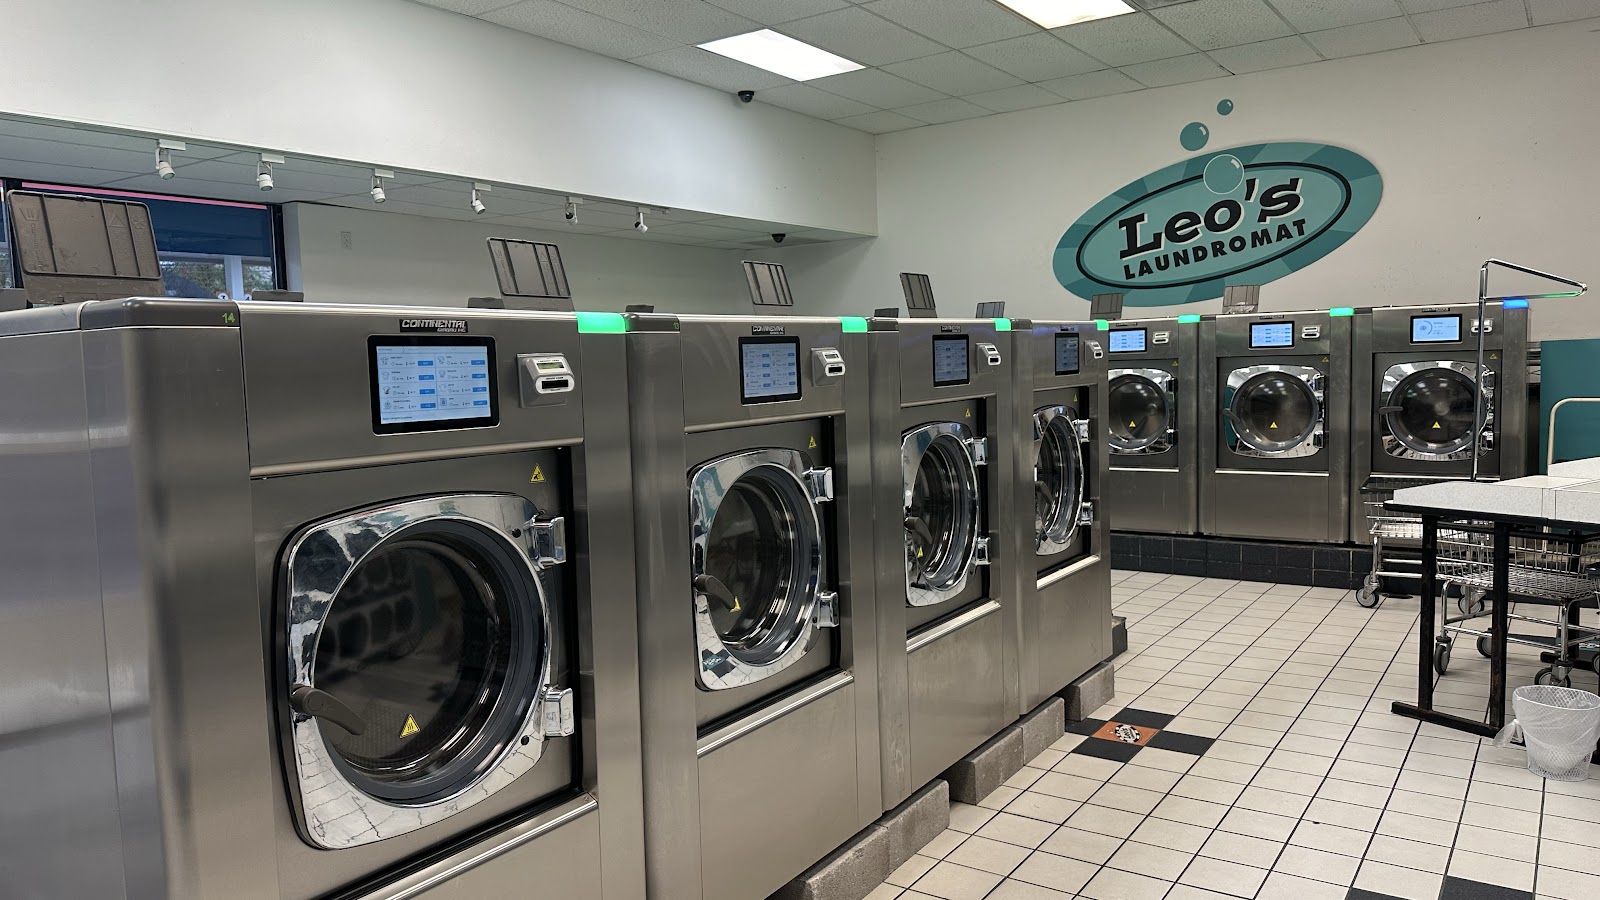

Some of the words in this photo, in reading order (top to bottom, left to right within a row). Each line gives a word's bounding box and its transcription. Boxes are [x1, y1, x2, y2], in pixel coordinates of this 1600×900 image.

[1119, 178, 1303, 259] Leo's
[1123, 219, 1306, 280] LAUNDROMAT
[222, 312, 235, 323] 14
[402, 319, 466, 328] CONTINENTAL
